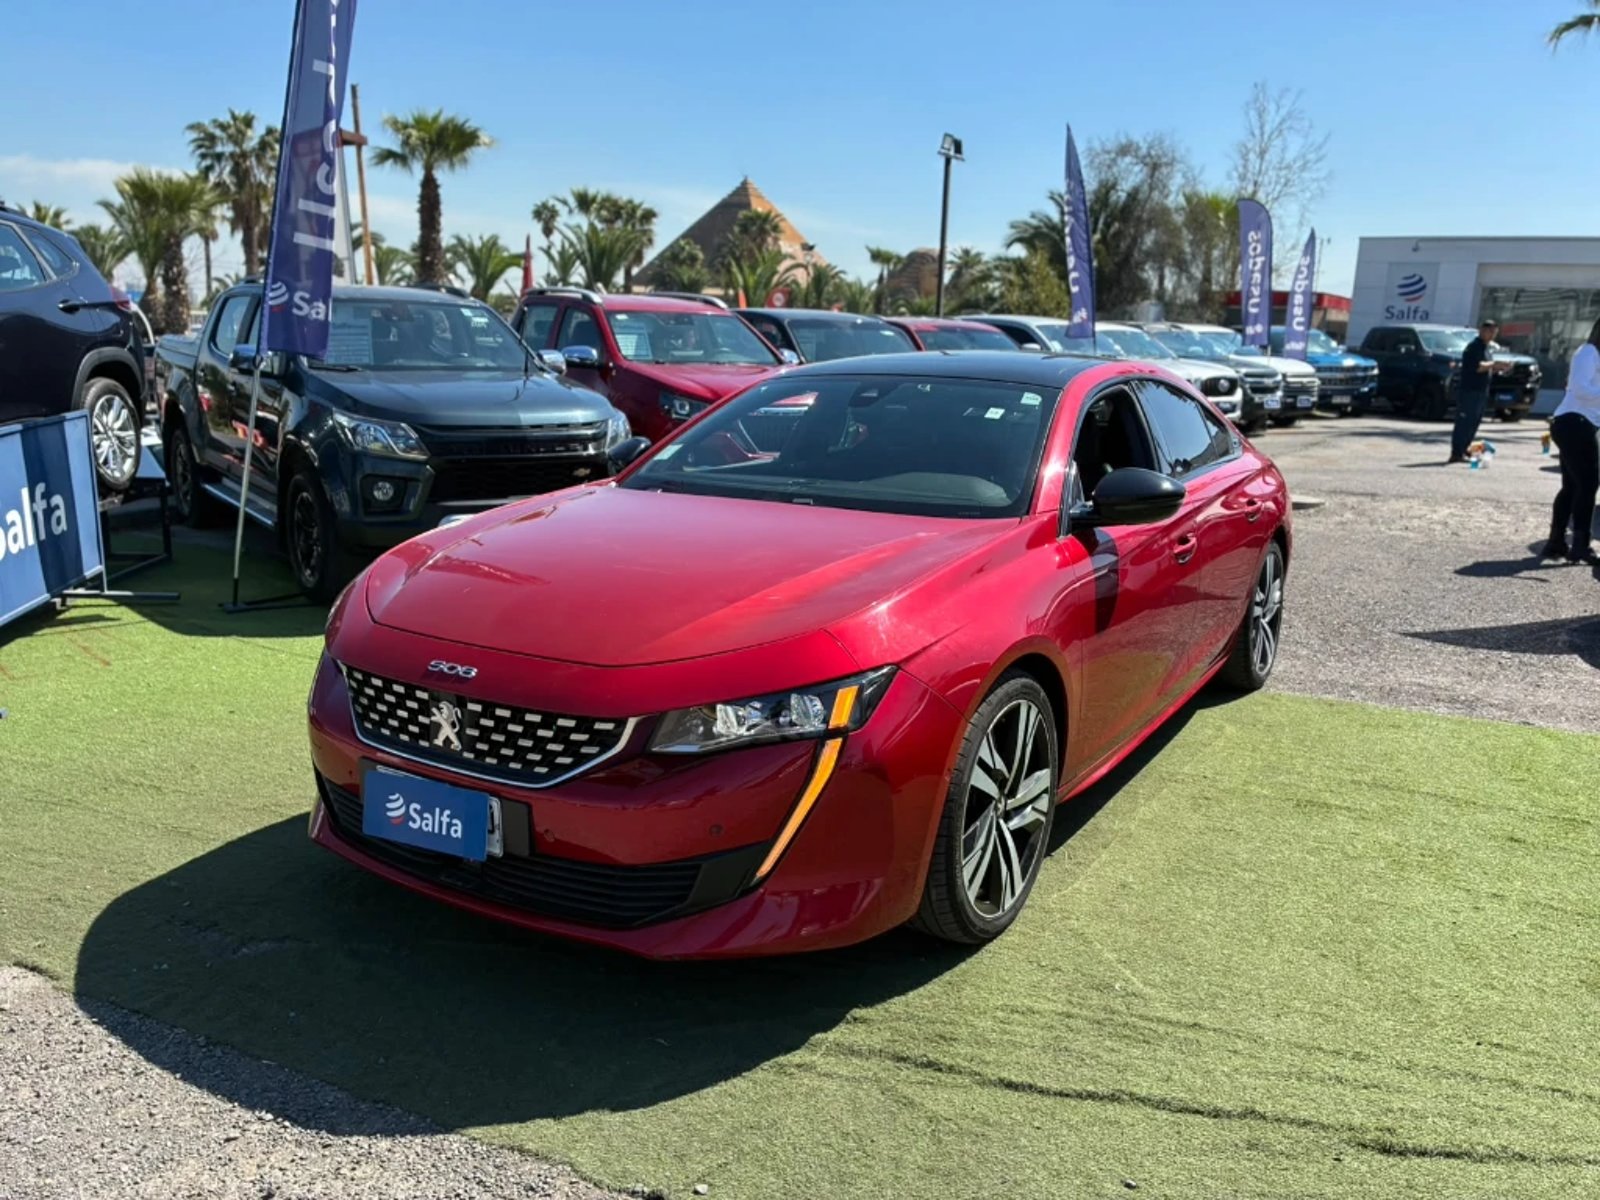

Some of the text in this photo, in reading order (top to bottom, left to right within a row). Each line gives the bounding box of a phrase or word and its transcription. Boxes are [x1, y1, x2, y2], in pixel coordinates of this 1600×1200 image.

[1385, 305, 1430, 321] Salfa
[428, 660, 478, 678] 508
[408, 803, 463, 839] Salfa
